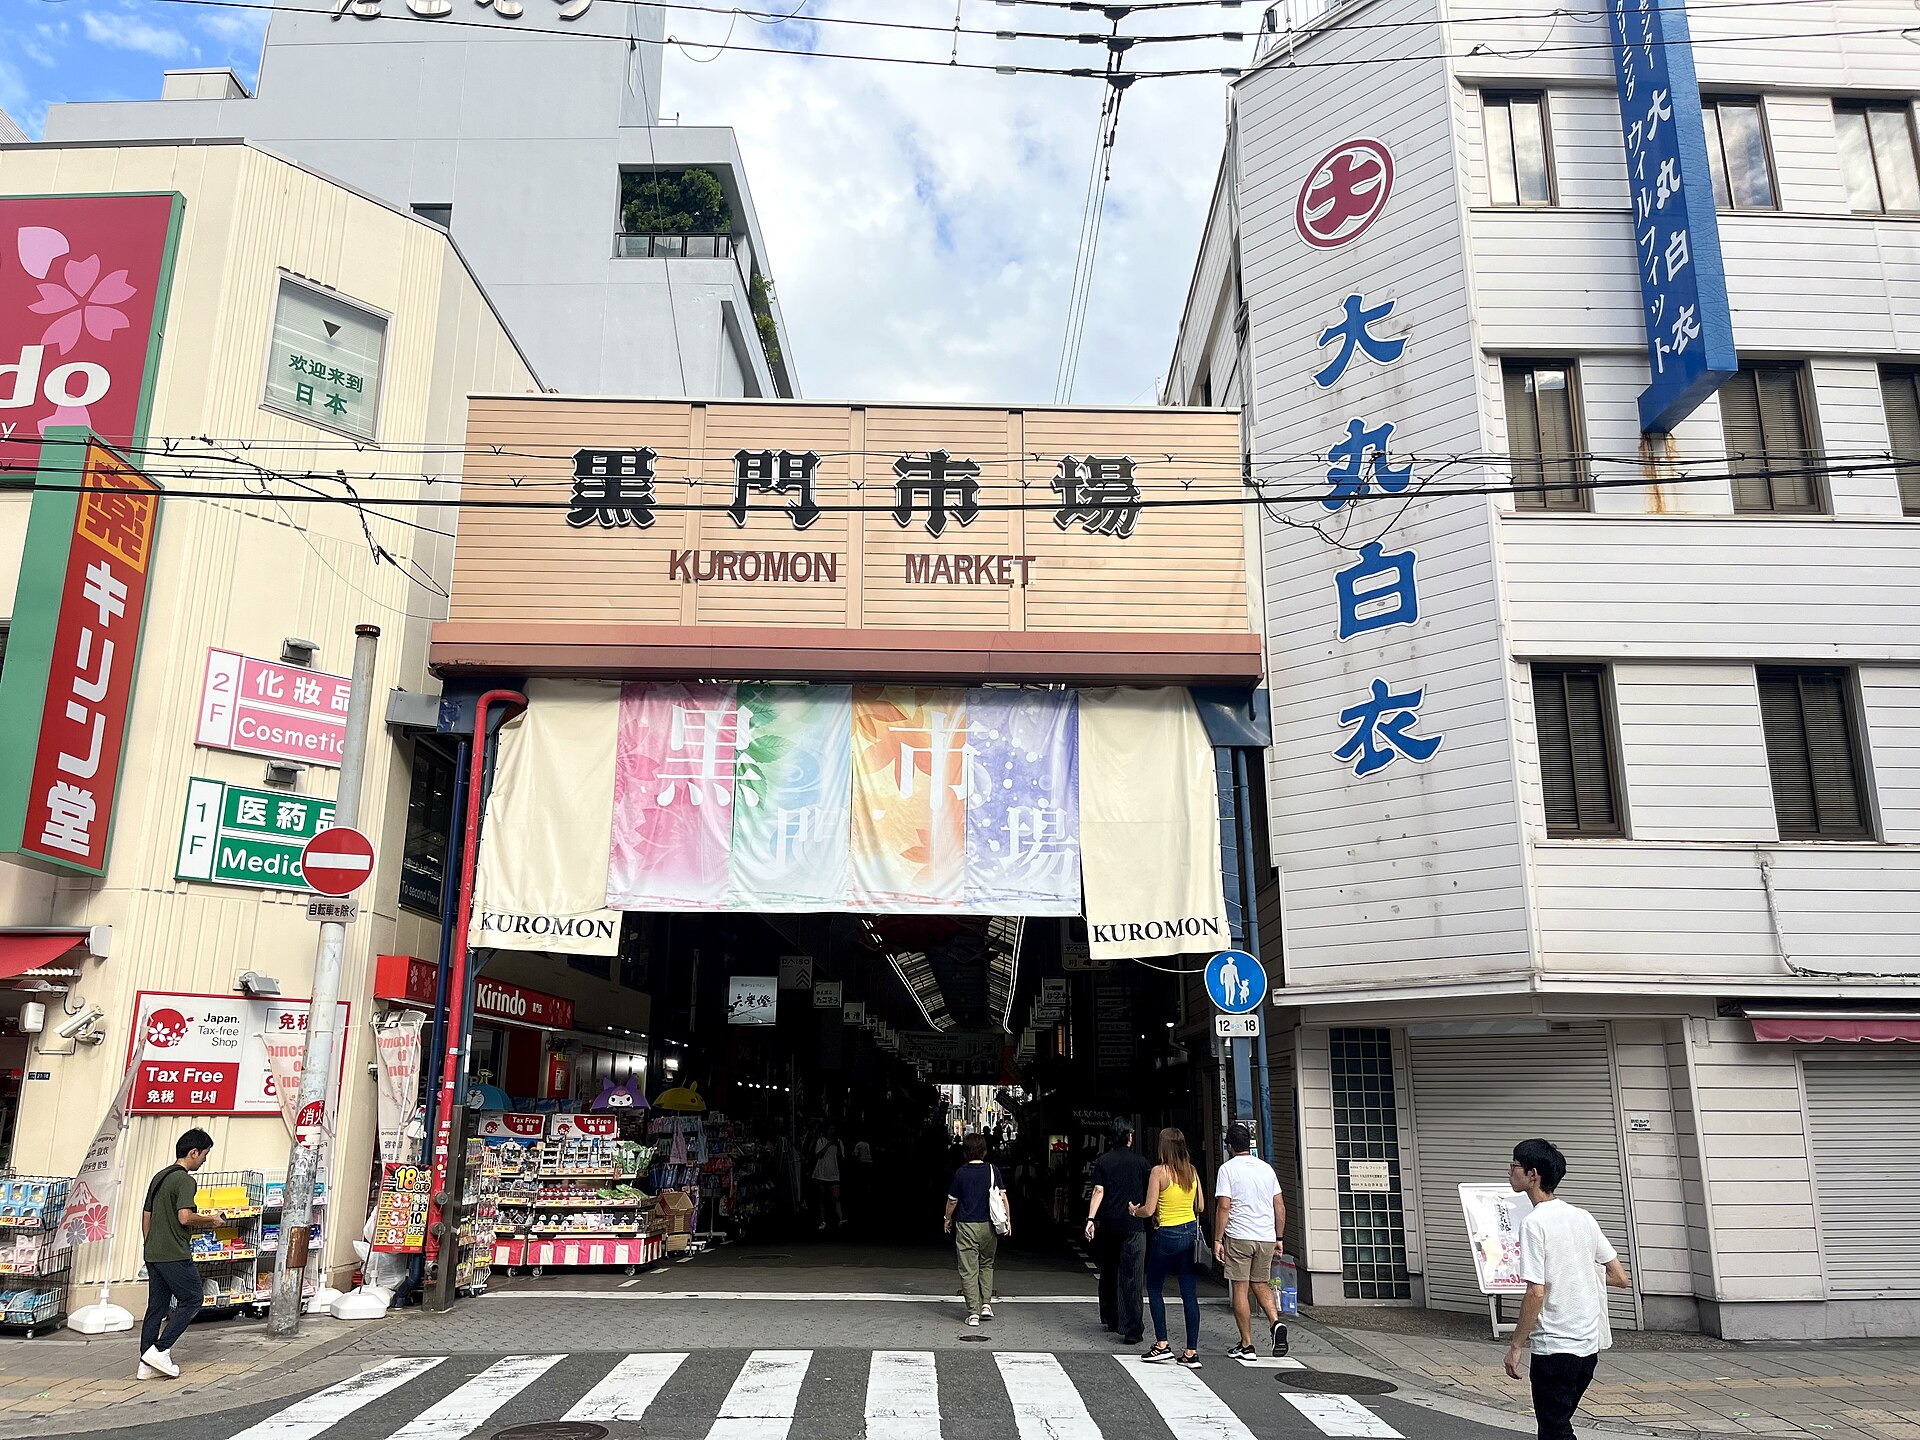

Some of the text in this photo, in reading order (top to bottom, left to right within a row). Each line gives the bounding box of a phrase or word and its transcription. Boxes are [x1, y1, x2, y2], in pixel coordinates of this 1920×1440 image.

[1646, 88, 1701, 356] 大丸白衣
[288, 354, 364, 393] 欢迎来到
[295, 383, 348, 417] 日本
[565, 446, 1143, 538] 黒門市場
[85, 460, 148, 563] 薬
[1313, 293, 1445, 778] 大丸白衣
[670, 549, 1036, 586] KUROMON MARKET
[40, 560, 128, 857] キリン堂
[308, 903, 356, 917] 自転車を除く
[479, 912, 615, 940] KUROMON
[1093, 916, 1219, 943] KUROMON
[476, 983, 527, 1016] Kirindo
[198, 1025, 239, 1036] Tax-free
[203, 1013, 240, 1024] Japan.
[212, 1037, 238, 1048] Shop
[146, 1067, 223, 1083] Tax Free
[147, 1090, 217, 1103] 免税 면세
